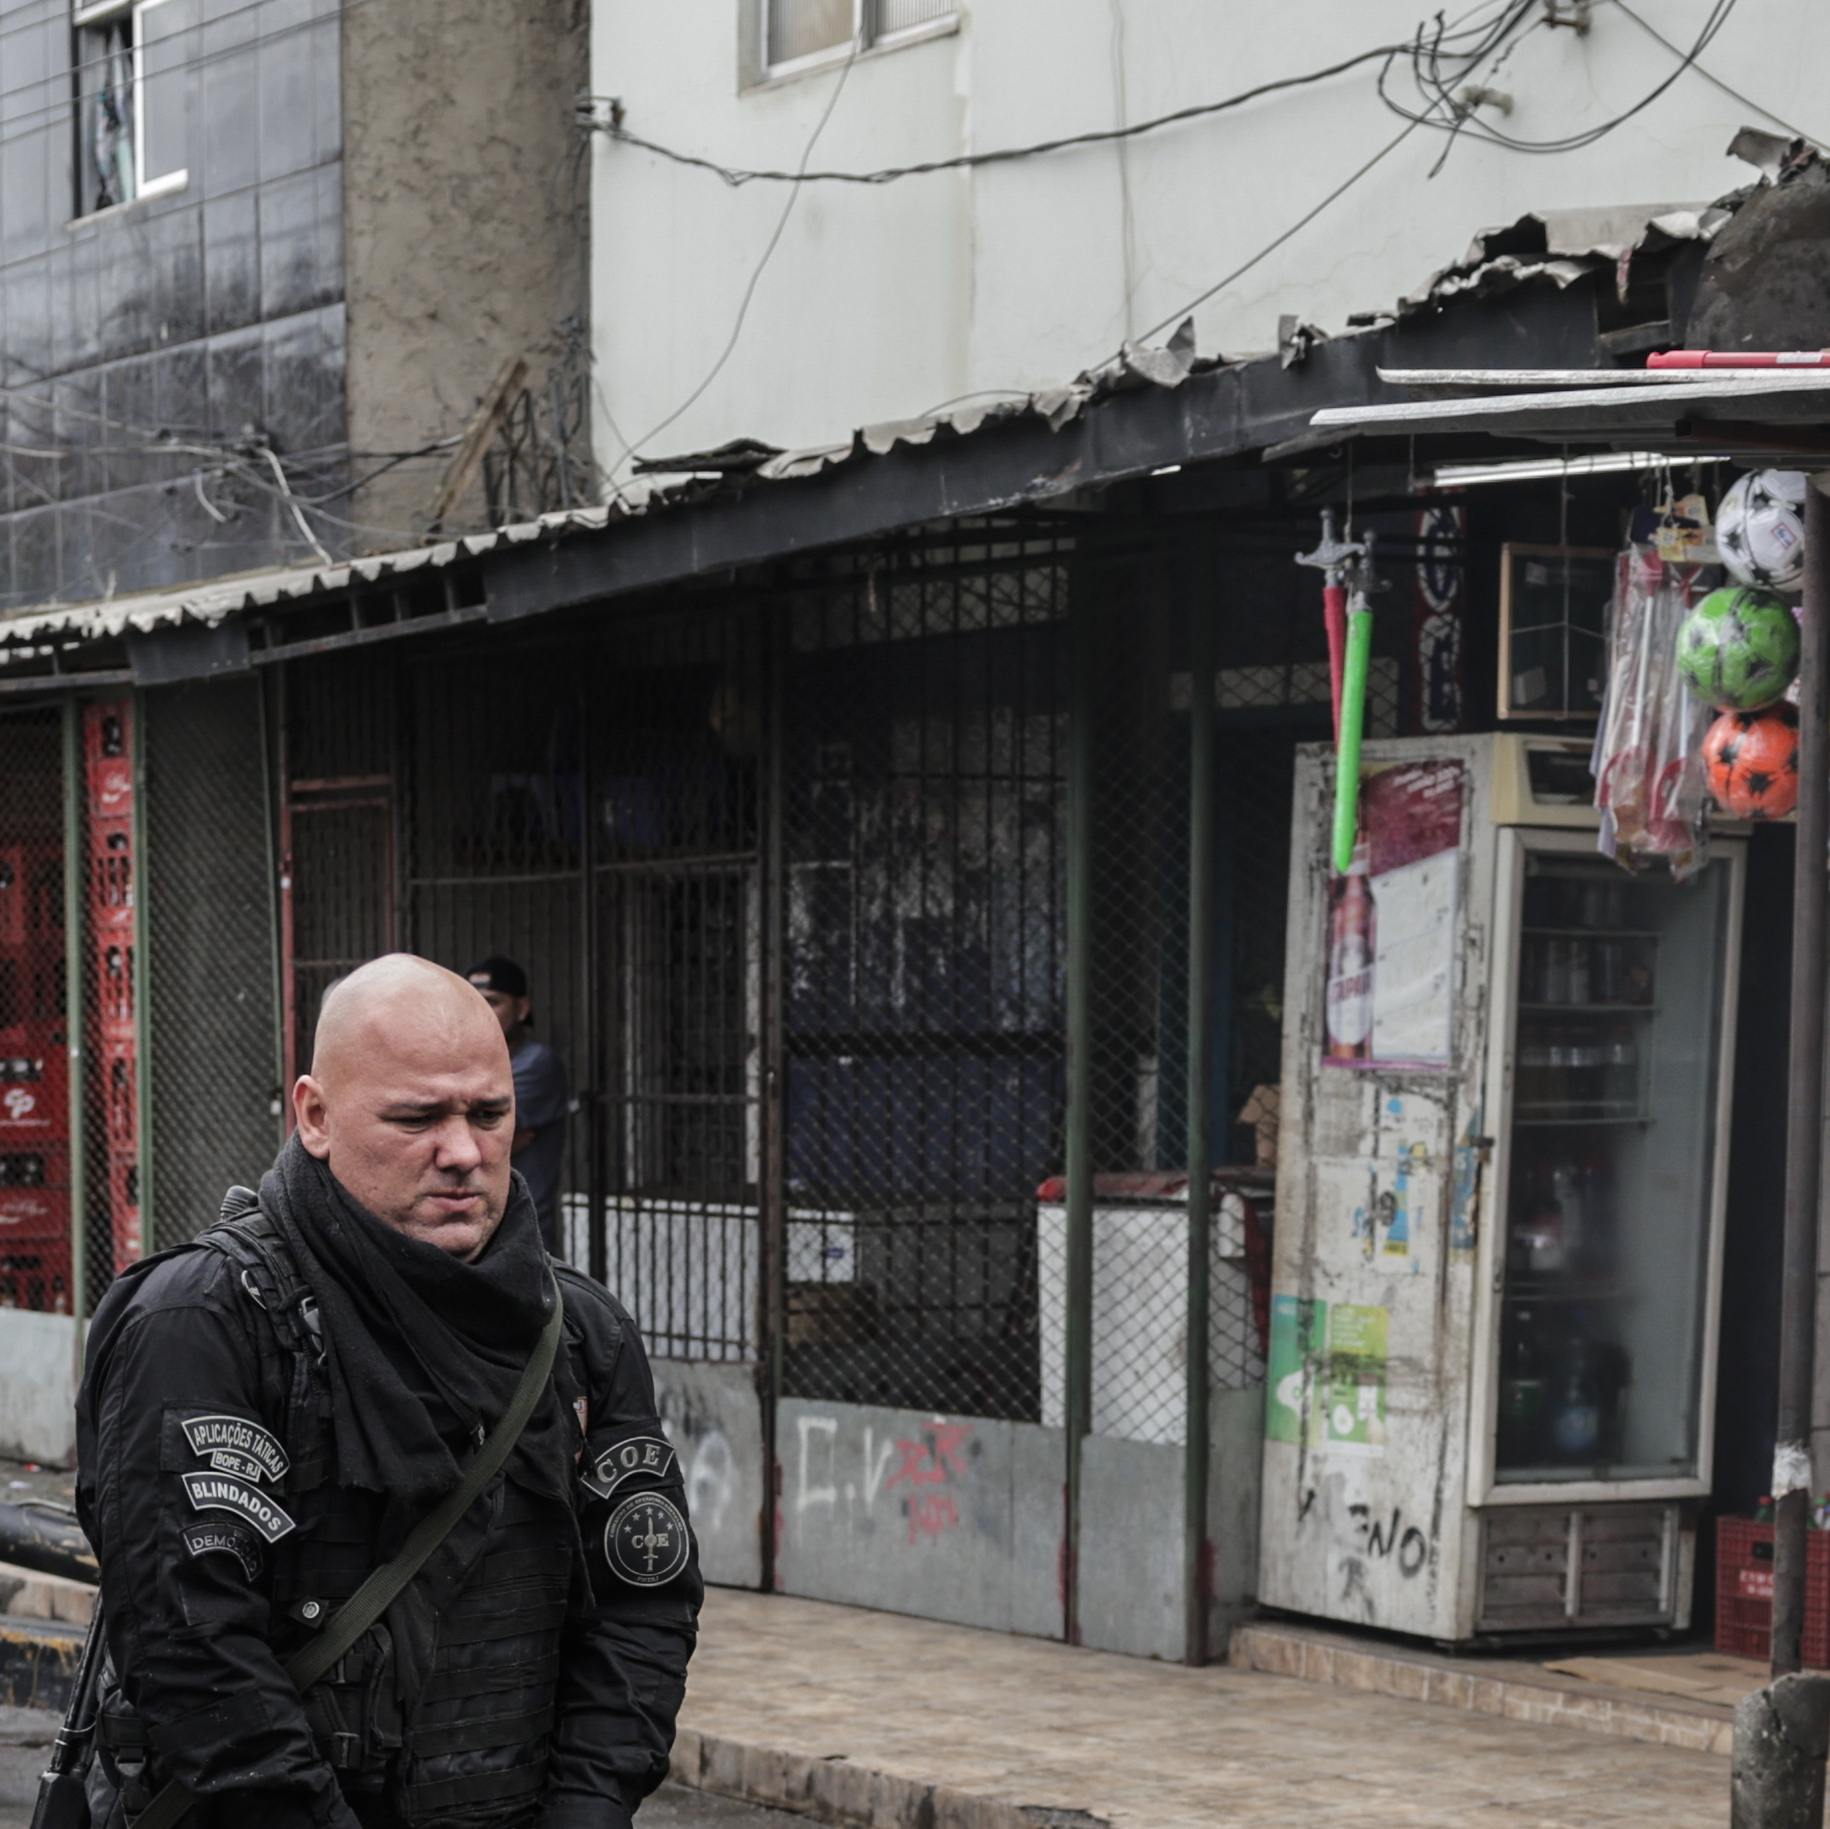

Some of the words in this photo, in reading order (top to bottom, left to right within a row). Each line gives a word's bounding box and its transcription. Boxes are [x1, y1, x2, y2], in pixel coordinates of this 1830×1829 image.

[193, 1422, 253, 1448] APLICAÇÕES
[253, 1434, 284, 1474] TÁTICAS
[215, 1452, 242, 1471] BOPE
[246, 1462, 259, 1477] RJ
[597, 1443, 661, 1483] COE
[191, 1482, 282, 1532] BLINDADOS
